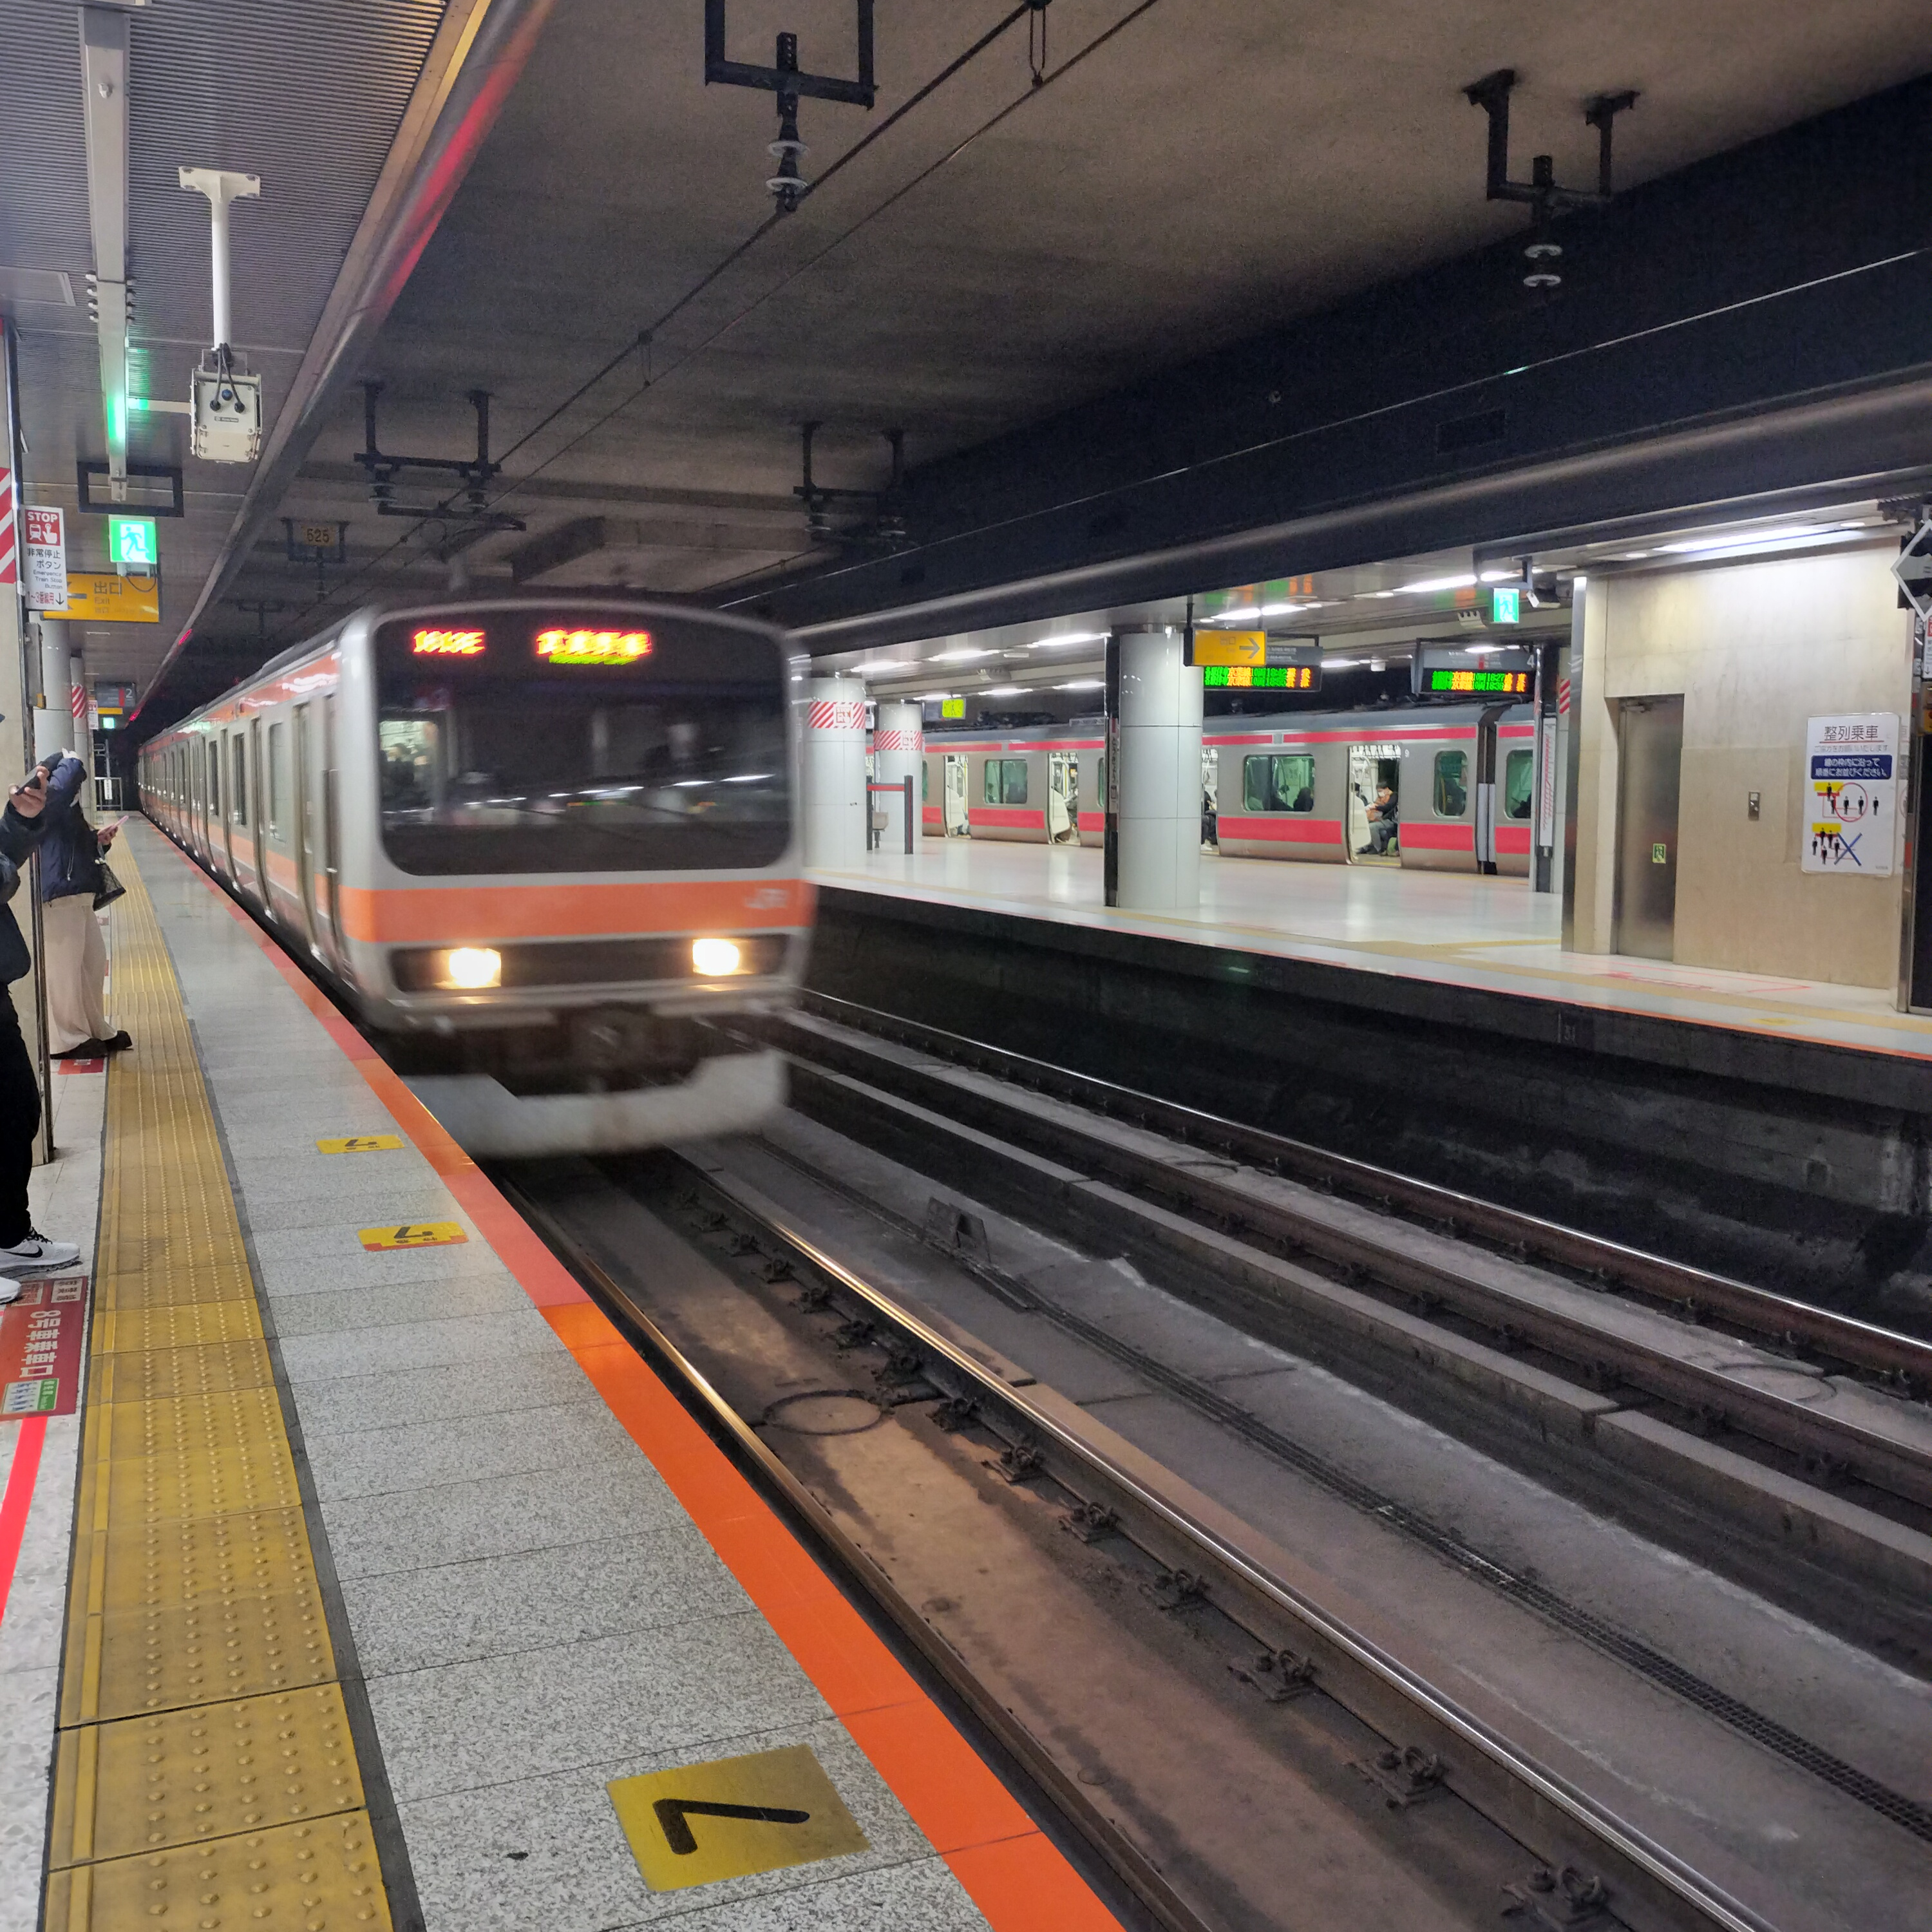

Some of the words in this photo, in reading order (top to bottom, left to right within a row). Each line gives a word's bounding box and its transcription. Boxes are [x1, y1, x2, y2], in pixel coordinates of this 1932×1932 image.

[28, 511, 58, 522] STOP
[307, 528, 330, 543] 525
[27, 548, 61, 559] 非常停止
[37, 560, 61, 569] ボタン
[95, 582, 122, 594] 出口
[1527, 654, 1535, 668] 4
[126, 688, 133, 698] 2
[1824, 725, 1879, 741] 整列乗車
[19, 1309, 61, 1378] 8号車乗車口
[652, 1798, 810, 1855] 7
